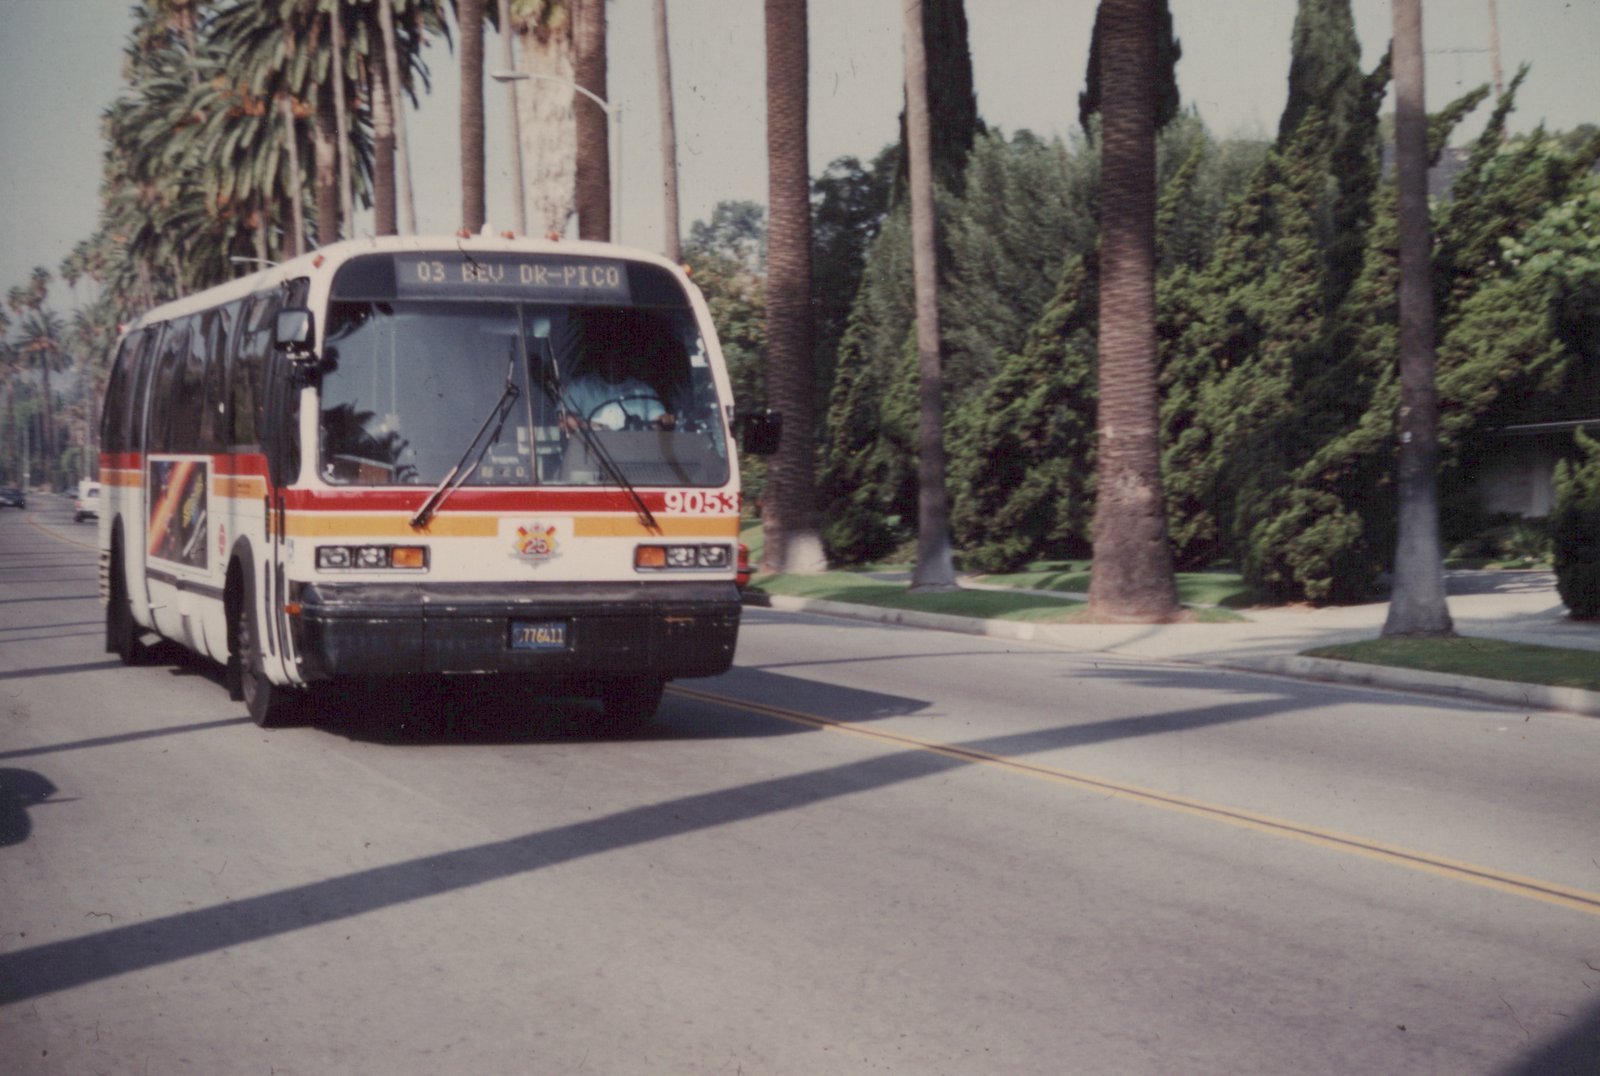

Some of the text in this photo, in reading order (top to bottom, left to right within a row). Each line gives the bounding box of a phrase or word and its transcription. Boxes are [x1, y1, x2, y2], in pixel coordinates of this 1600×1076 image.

[416, 261, 620, 287] 03 BEV DR-PICO
[664, 491, 740, 514] 9053
